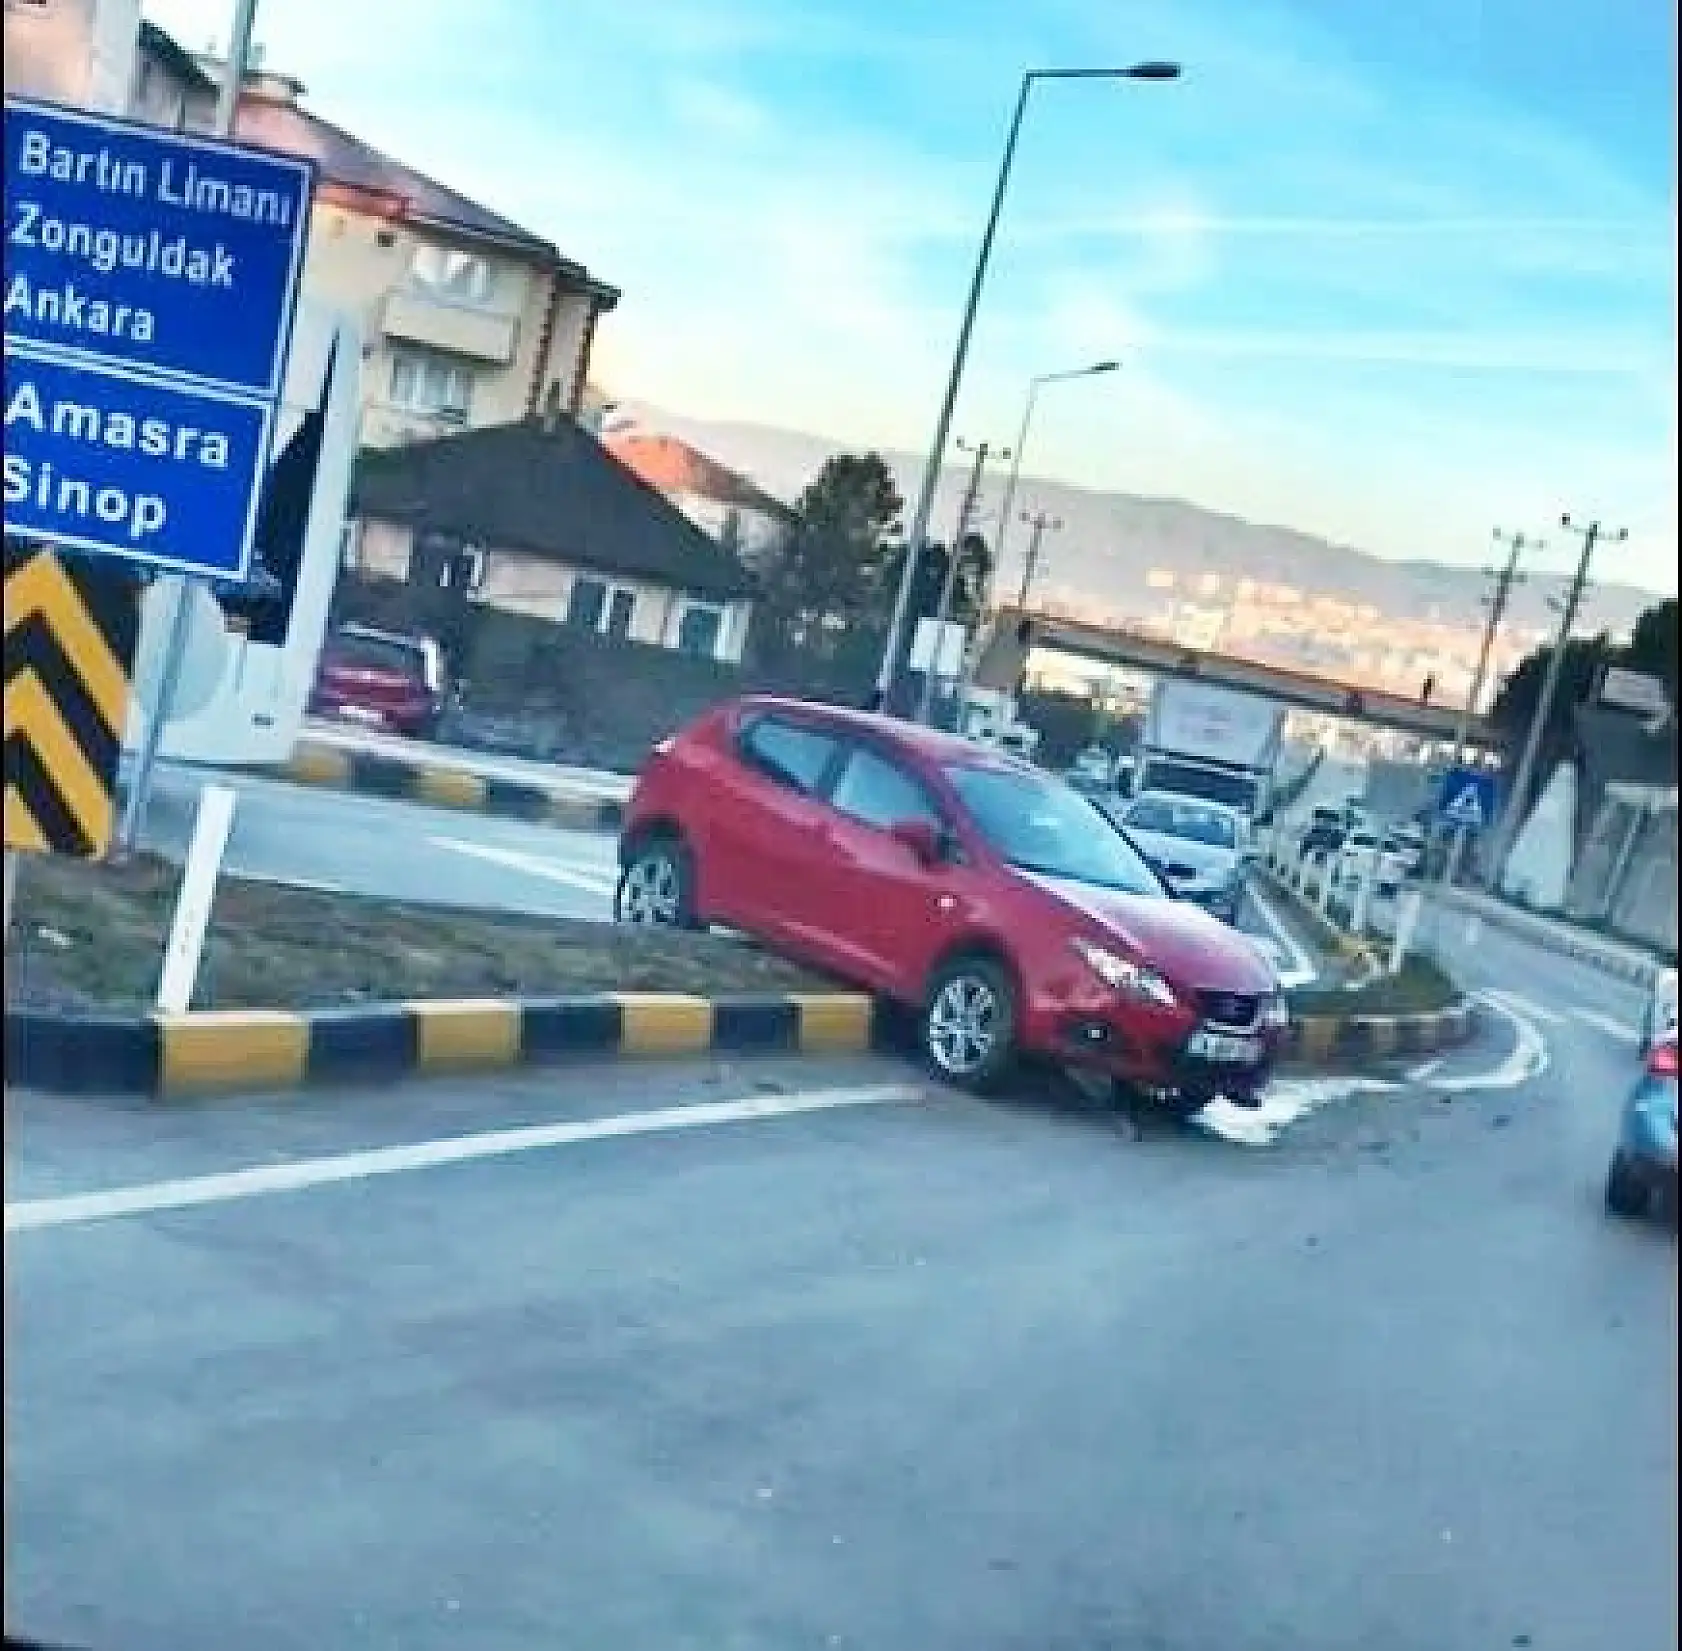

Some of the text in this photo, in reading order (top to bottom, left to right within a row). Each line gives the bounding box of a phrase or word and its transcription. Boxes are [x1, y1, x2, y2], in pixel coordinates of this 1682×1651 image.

[20, 130, 291, 225] Bartın Limanı
[10, 203, 236, 287] Zonguldak
[5, 274, 155, 341] Ankara
[5, 382, 229, 467] Amasra
[4, 455, 167, 537] Sinop
